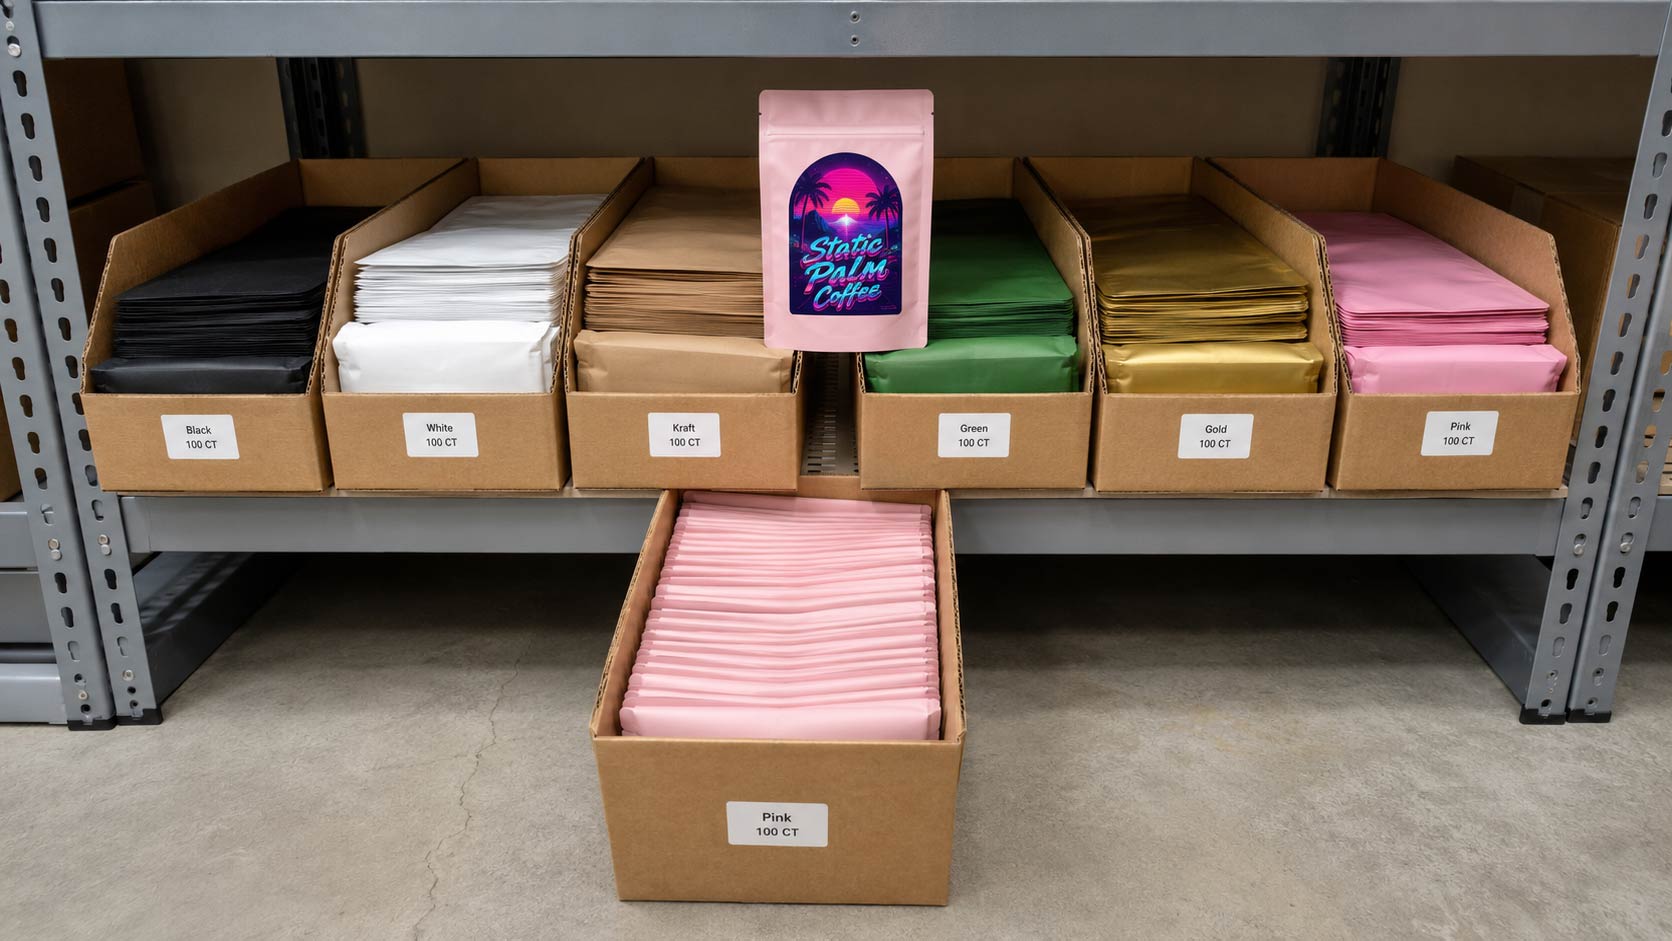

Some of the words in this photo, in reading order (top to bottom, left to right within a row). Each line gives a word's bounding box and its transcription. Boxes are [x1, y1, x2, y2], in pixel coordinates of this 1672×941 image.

[801, 233, 884, 265] Static
[803, 255, 889, 295] Palm
[813, 281, 882, 311] Coffee
[185, 425, 212, 435] Black
[425, 423, 454, 433] White
[672, 423, 696, 433] Kraft
[960, 423, 989, 433] Green
[1204, 424, 1228, 434] Gold
[1450, 421, 1471, 431] Pink
[186, 439, 203, 449] 100
[204, 439, 218, 449] CT
[426, 437, 443, 447] 100
[444, 437, 458, 447] CT
[669, 437, 686, 447] 100
[687, 437, 701, 447] CT
[958, 438, 975, 448] 100
[976, 438, 991, 448] CT
[1199, 439, 1217, 449] 100
[1217, 439, 1232, 449] CT
[1443, 436, 1460, 446] 100
[1461, 436, 1476, 446] CT
[762, 812, 792, 823] Pink
[755, 826, 779, 837] 100
[781, 827, 800, 837] CT
